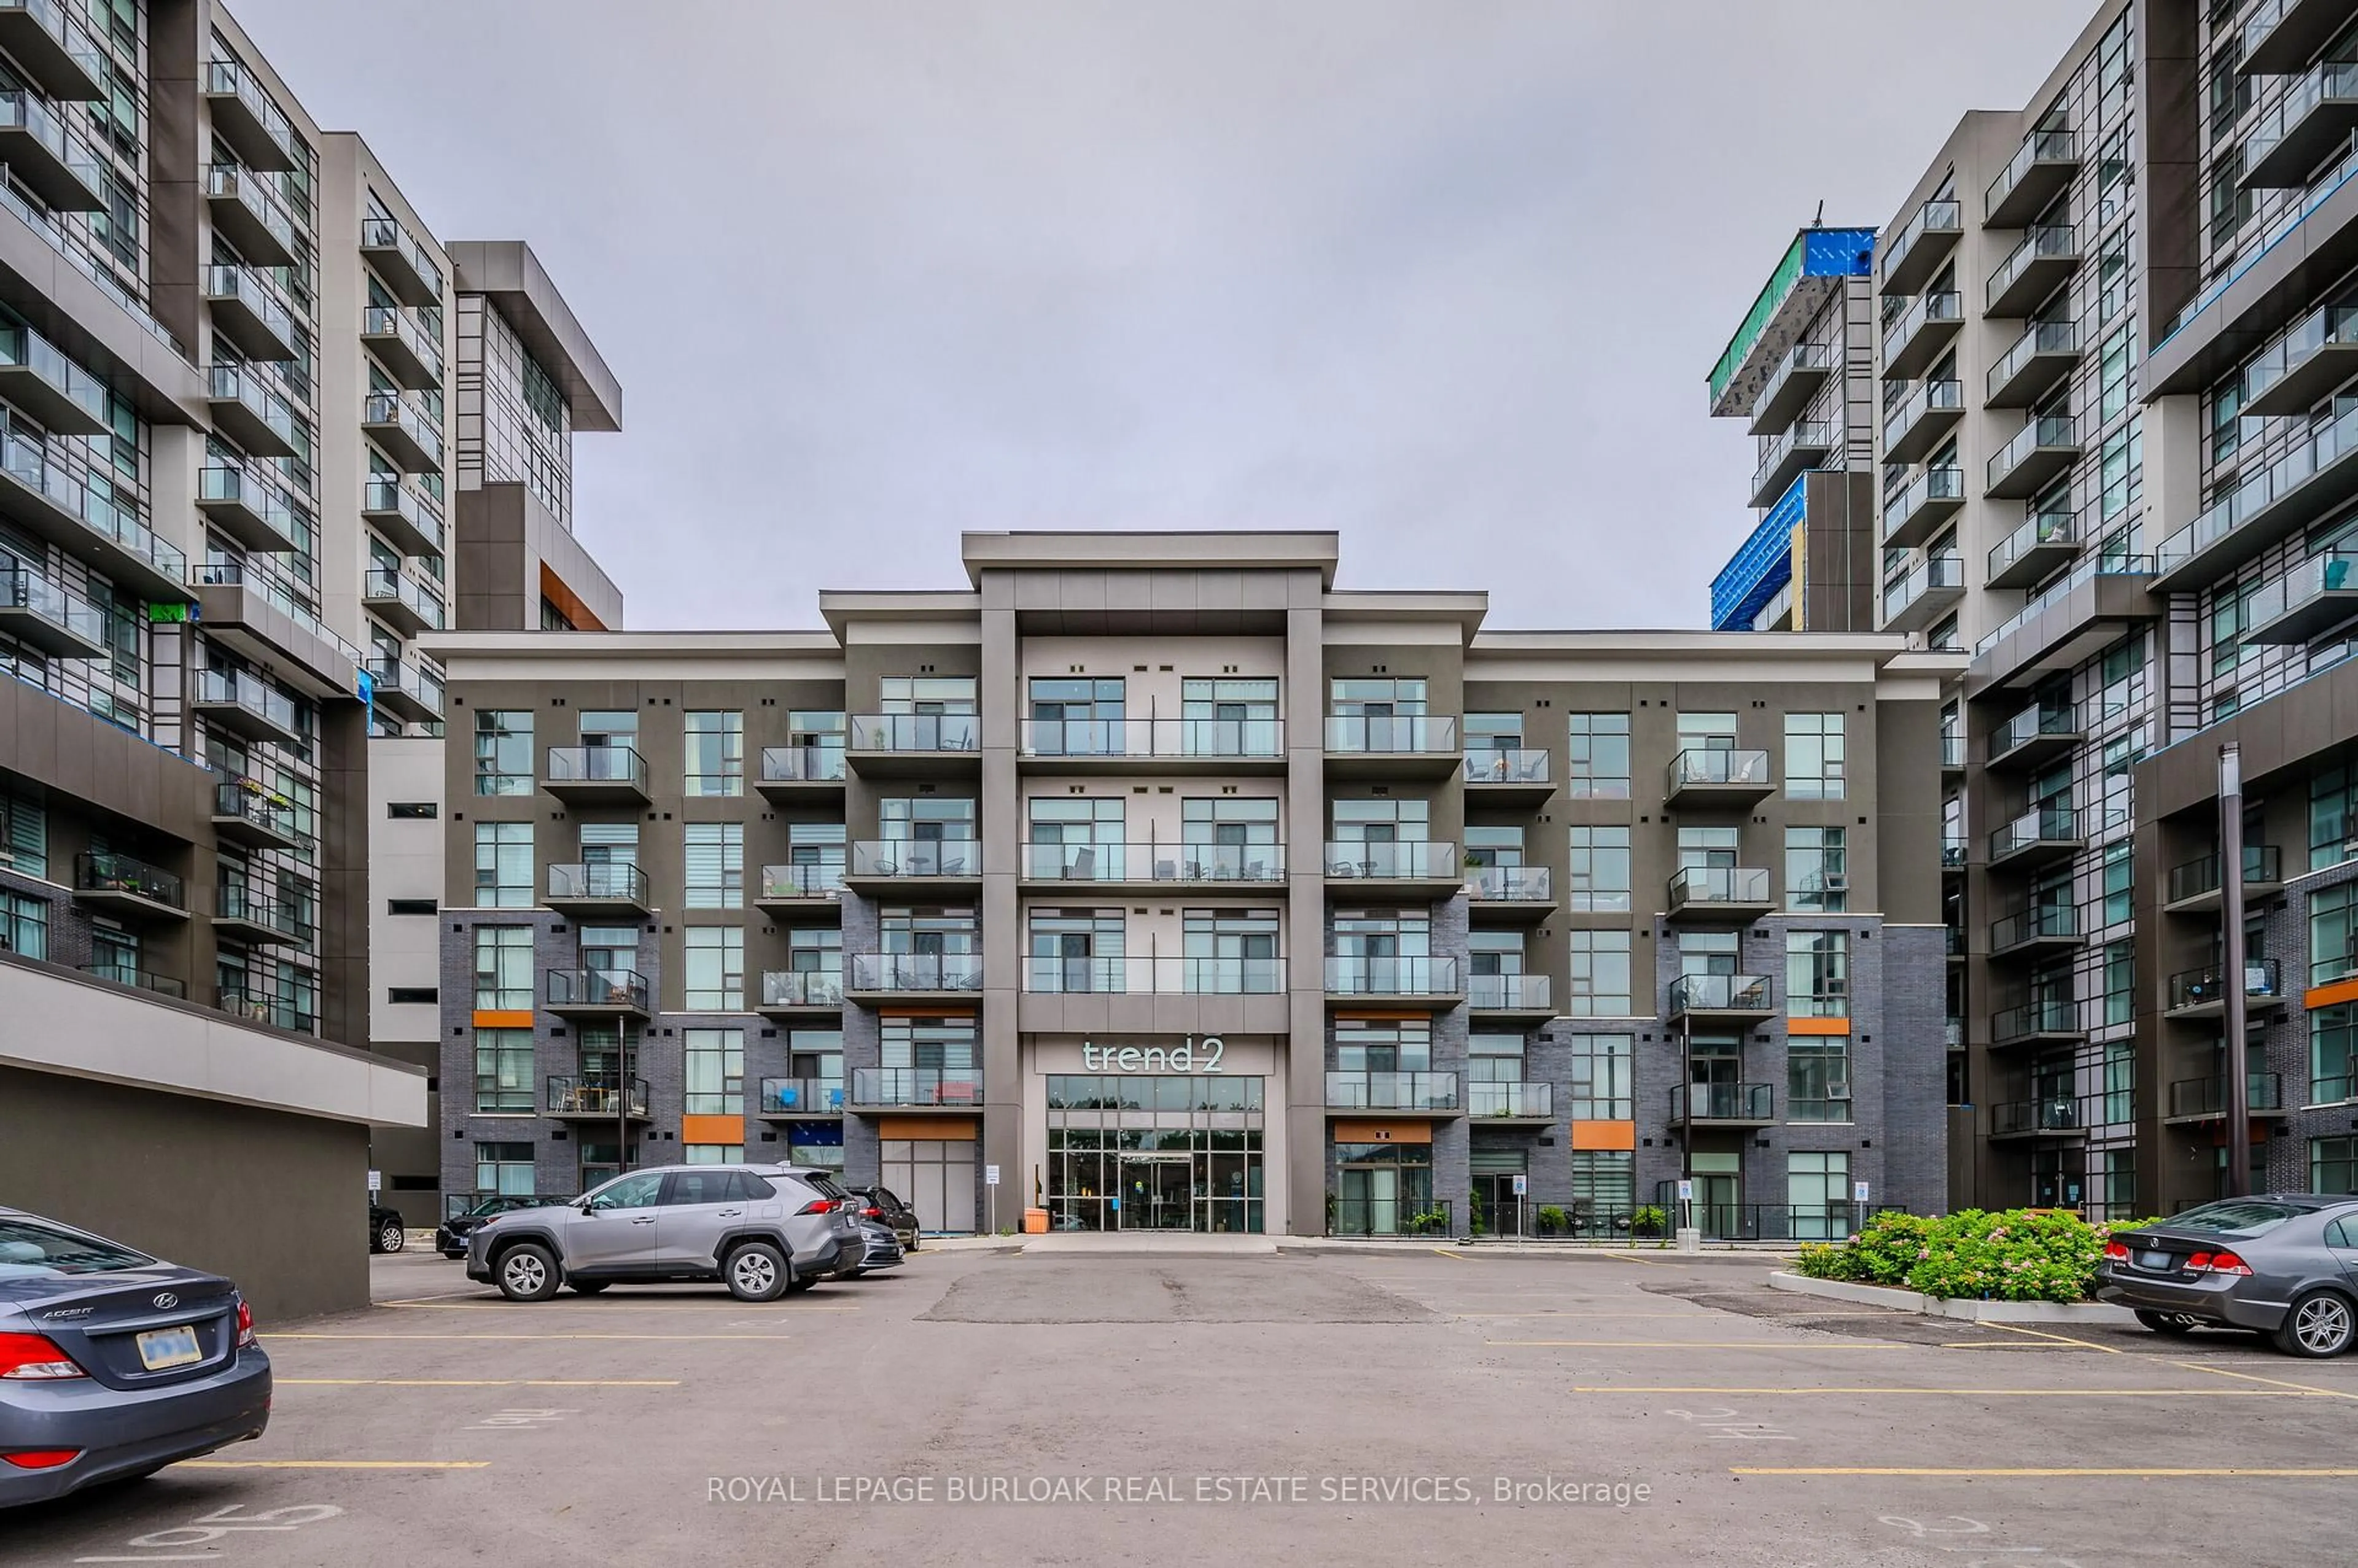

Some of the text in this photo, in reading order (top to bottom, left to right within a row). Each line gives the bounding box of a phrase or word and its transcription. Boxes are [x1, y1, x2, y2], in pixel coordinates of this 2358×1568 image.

[1083, 1038, 1224, 1072] trend 2
[42, 1306, 95, 1319] ACCENT
